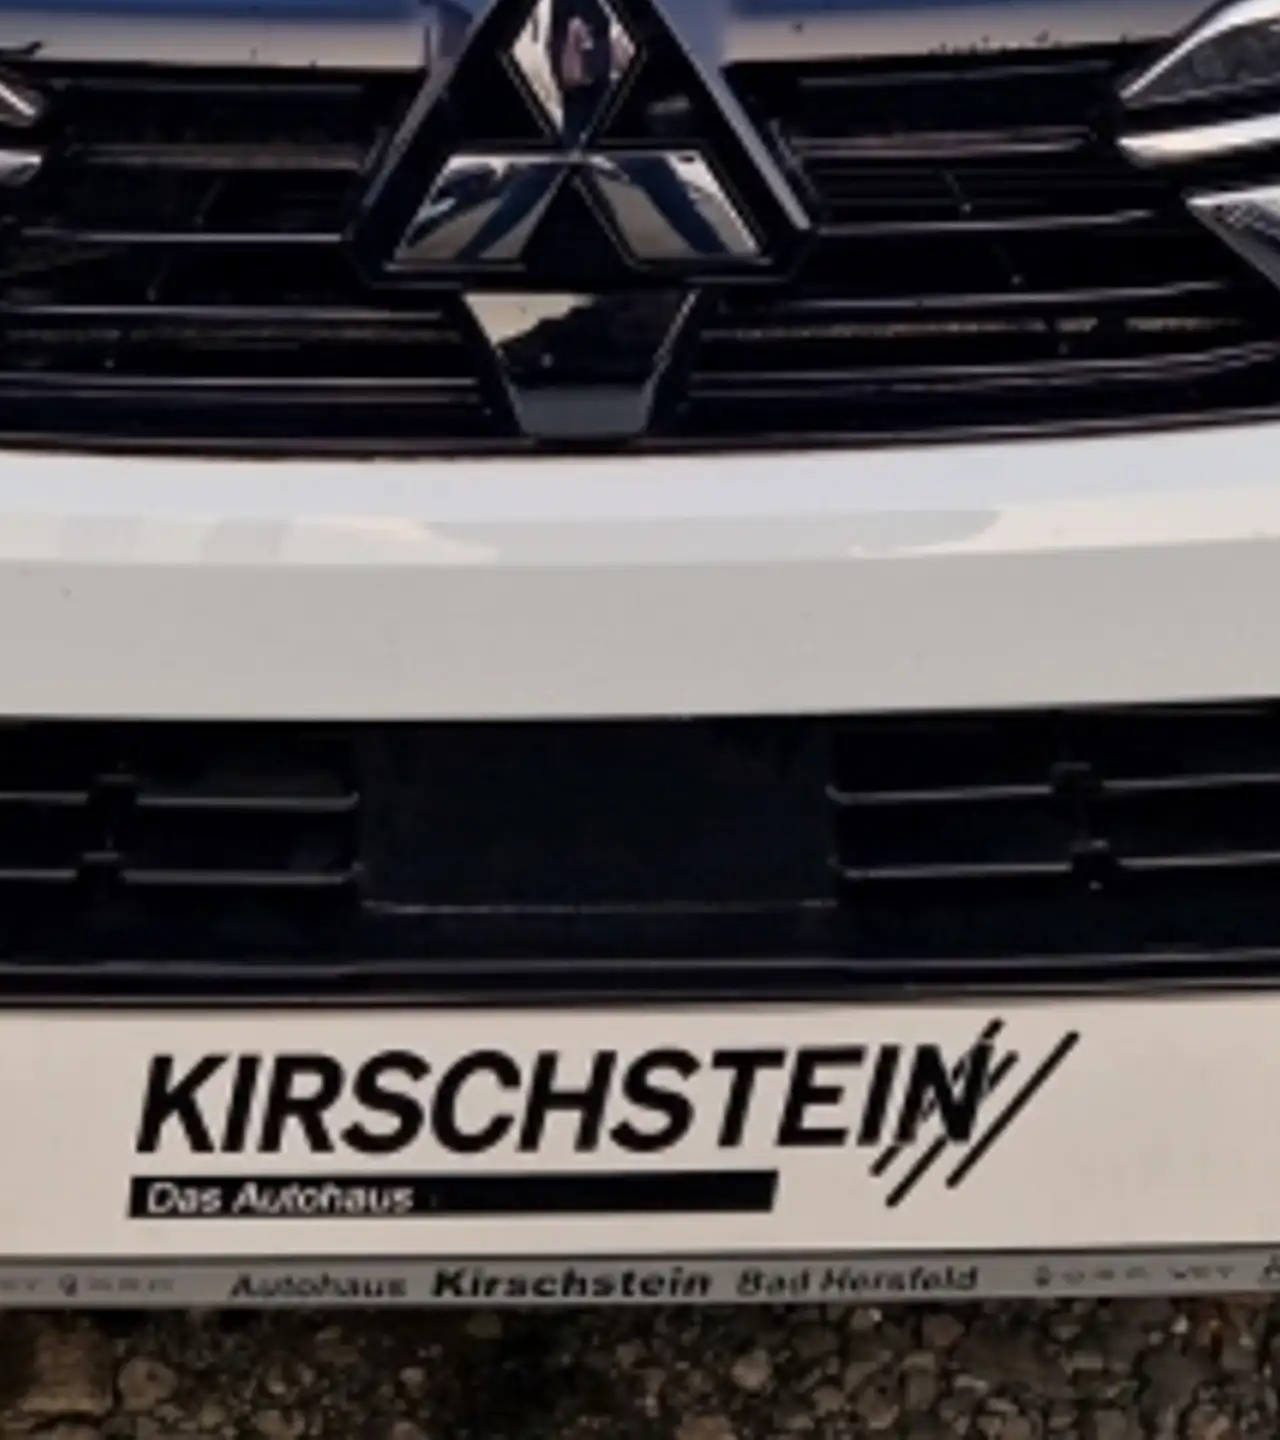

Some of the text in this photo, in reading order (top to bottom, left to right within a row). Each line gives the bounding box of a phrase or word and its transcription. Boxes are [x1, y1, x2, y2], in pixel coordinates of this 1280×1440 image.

[134, 1042, 995, 1154] KIRSCHSTEIN
[145, 1180, 416, 1215] Das Autohaus
[229, 1264, 979, 1299] Autohaus Kirschstein Bad Hersfeld
